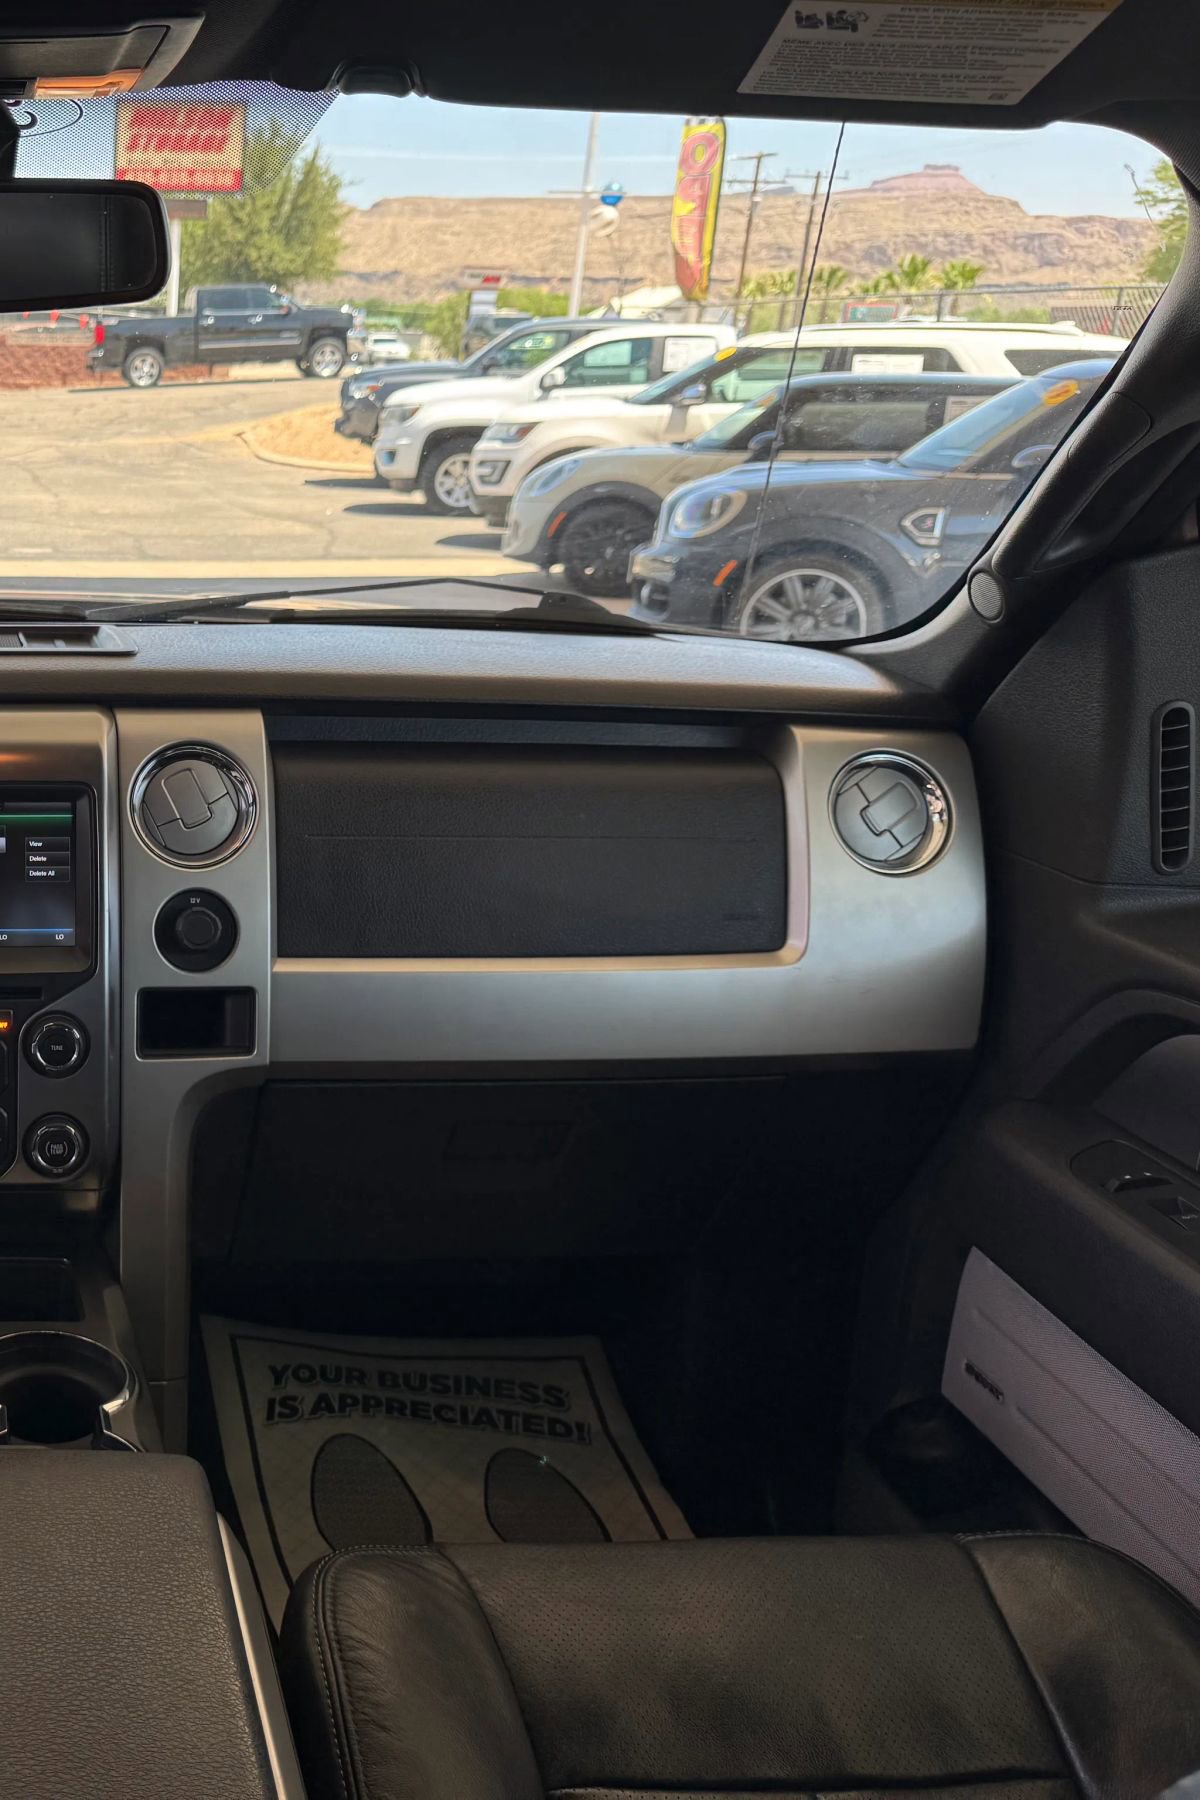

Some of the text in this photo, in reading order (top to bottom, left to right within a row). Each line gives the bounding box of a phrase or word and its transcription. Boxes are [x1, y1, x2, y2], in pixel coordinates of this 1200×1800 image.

[267, 1364, 570, 1408] YOUR BUSINESS
[266, 1392, 593, 1443] IS APPRECIATED!
